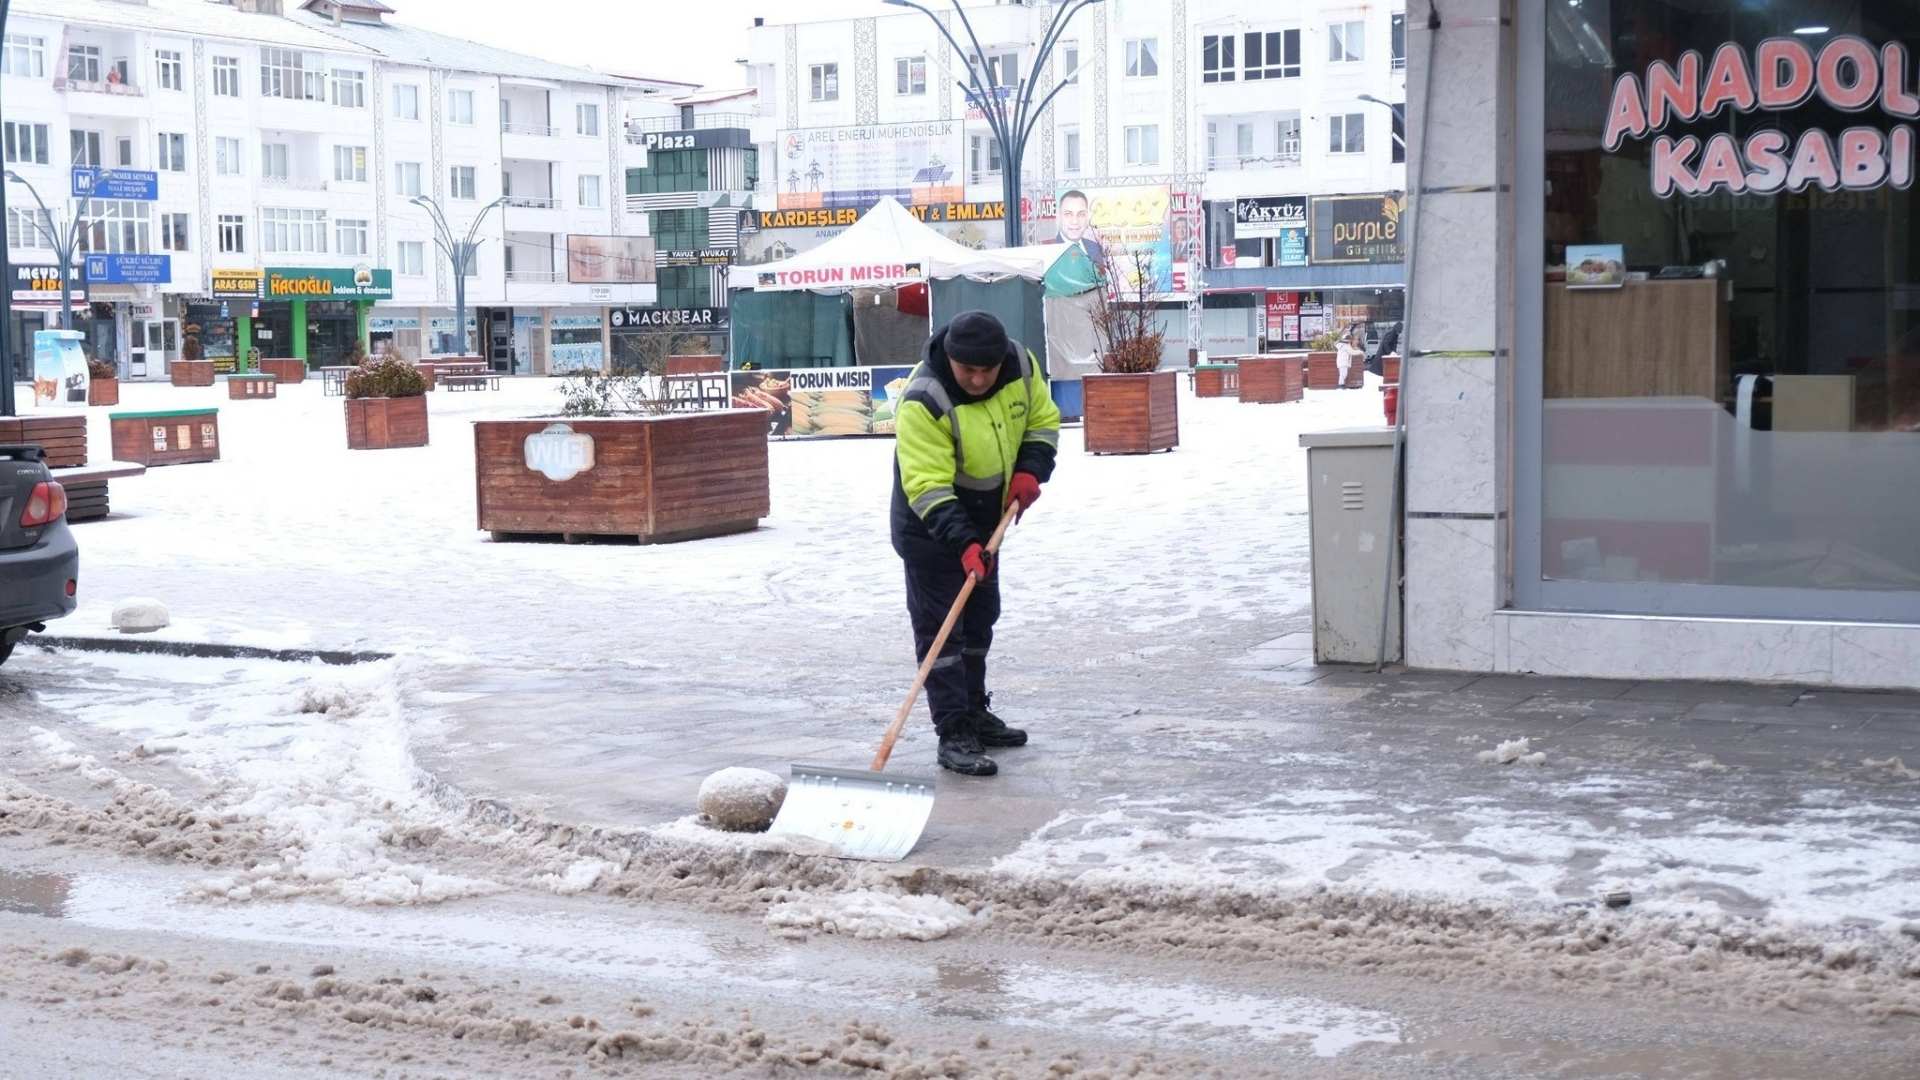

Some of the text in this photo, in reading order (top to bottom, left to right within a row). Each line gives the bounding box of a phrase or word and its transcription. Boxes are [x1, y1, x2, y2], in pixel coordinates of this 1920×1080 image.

[646, 132, 695, 151] Plaza
[807, 129, 836, 144] AREL
[1652, 124, 1914, 197] KASABI
[760, 207, 858, 228] KARDEŞLER
[932, 208, 940, 220] &
[946, 202, 1005, 220] EMLAK
[1248, 203, 1304, 218] AKYÜZ
[1334, 221, 1396, 245] purple
[700, 249, 729, 257] AVUKAT
[18, 267, 79, 280] MEYDN
[777, 264, 905, 286] TORUN MISIR
[215, 280, 256, 289] ARAS GSM
[270, 275, 331, 296] HACIOĞLU
[1268, 303, 1297, 312] SAADET
[629, 309, 712, 326] MACKBEAR
[791, 371, 870, 389] TORUN MISIR
